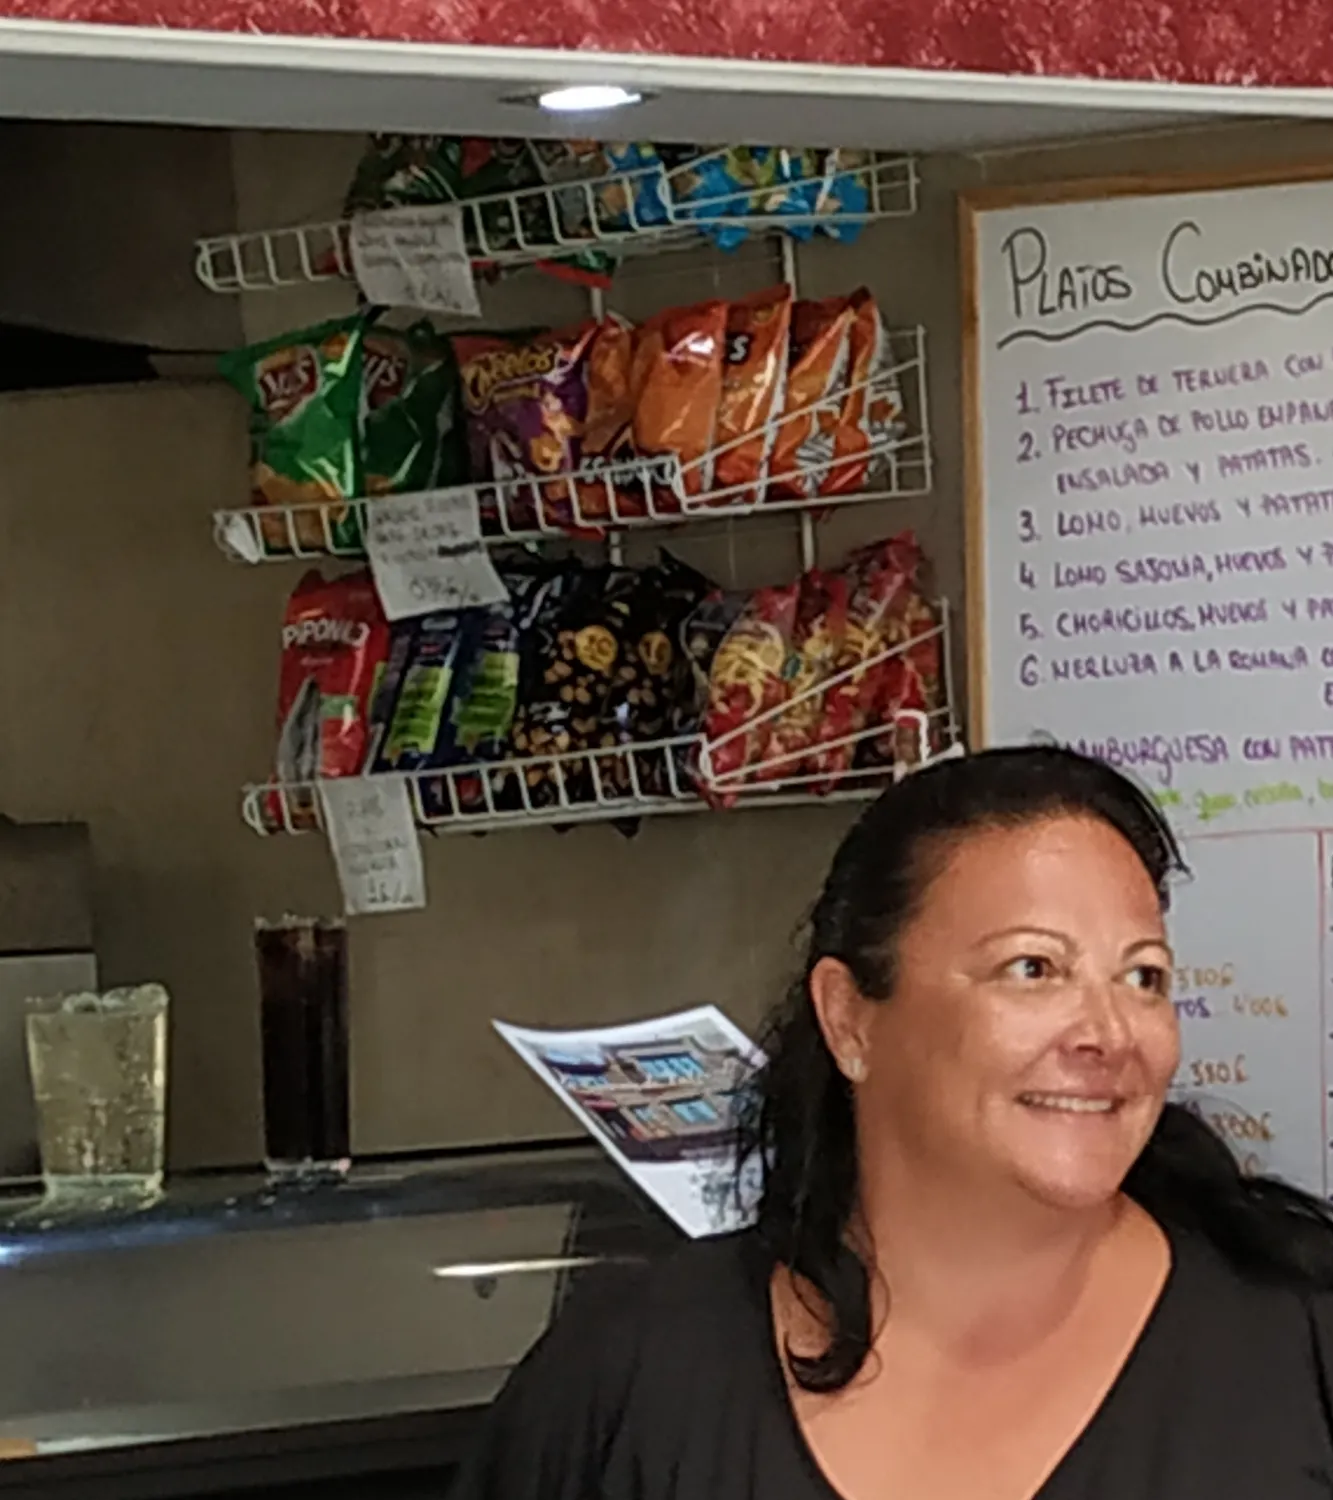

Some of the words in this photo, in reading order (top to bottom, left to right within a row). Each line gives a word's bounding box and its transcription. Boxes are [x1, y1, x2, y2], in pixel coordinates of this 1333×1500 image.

[1044, 375, 1127, 409] FILETE
[1137, 373, 1159, 396] DE
[1284, 353, 1324, 379] CON
[1016, 430, 1042, 463] 2.
[1158, 413, 1181, 437] DE
[1191, 408, 1249, 432] POLLO
[1185, 461, 1201, 484] Y
[1139, 500, 1222, 526] HUEVOS
[1236, 497, 1251, 518] Y
[1054, 561, 1107, 589] LOMO
[1296, 546, 1314, 566] Y
[1281, 599, 1297, 620] Y
[1051, 651, 1158, 681] MERLUZA
[1169, 651, 1184, 673] A
[1193, 649, 1222, 673] LA
[1243, 736, 1281, 760] CON
